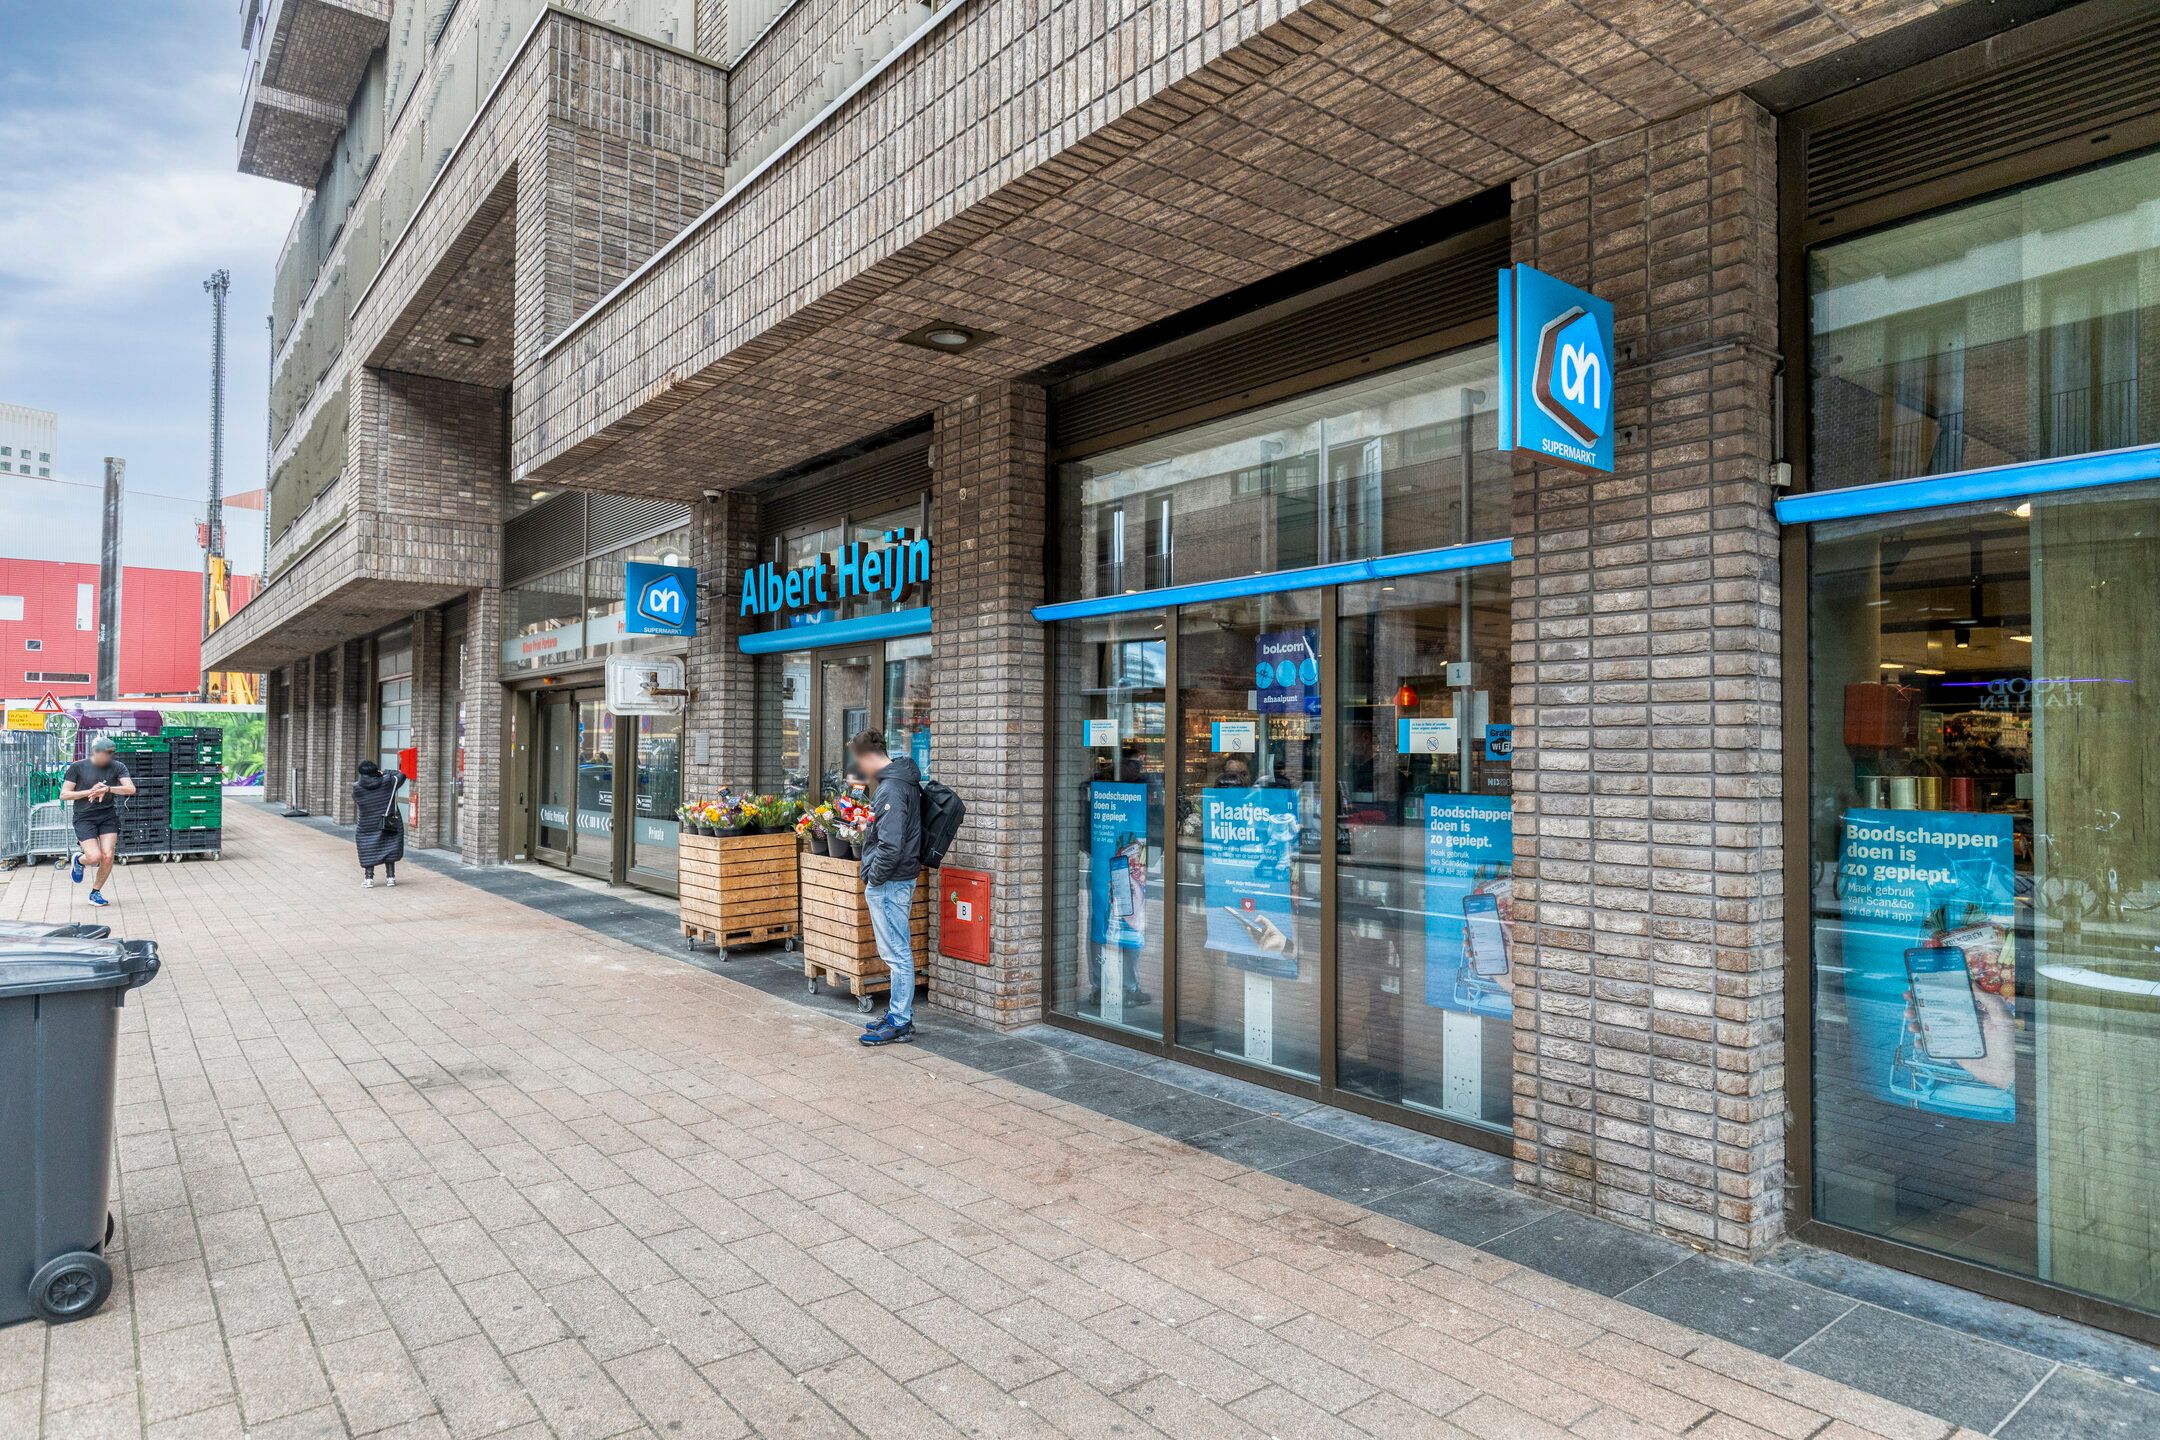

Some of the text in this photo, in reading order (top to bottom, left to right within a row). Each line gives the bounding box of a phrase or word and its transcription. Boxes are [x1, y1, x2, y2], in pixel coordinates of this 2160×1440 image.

[1542, 438, 1596, 465] SUPERMARKT
[740, 527, 930, 617] Albert Heijn
[643, 626, 682, 635] SUPERMARKT
[1263, 642, 1304, 654] bol.com
[1263, 694, 1298, 704] afhaalpunt
[1094, 791, 1142, 803] Boodschappen
[1094, 801, 1116, 810] doen is
[1102, 812, 1128, 822] gepiept.
[1210, 802, 1270, 825] Plaatjes
[1211, 820, 1260, 844] kijken.
[1430, 819, 1470, 832] doen is
[1430, 834, 1492, 849] zo gepiept.
[1846, 824, 1998, 849] Boodschappen
[1847, 842, 1916, 862] doen is
[1847, 863, 1957, 886] zo gepiept.
[1848, 883, 1915, 897] Maak gebruik
[1848, 896, 1915, 910] van Scan&Go
[1848, 906, 1915, 923] of de AH app.
